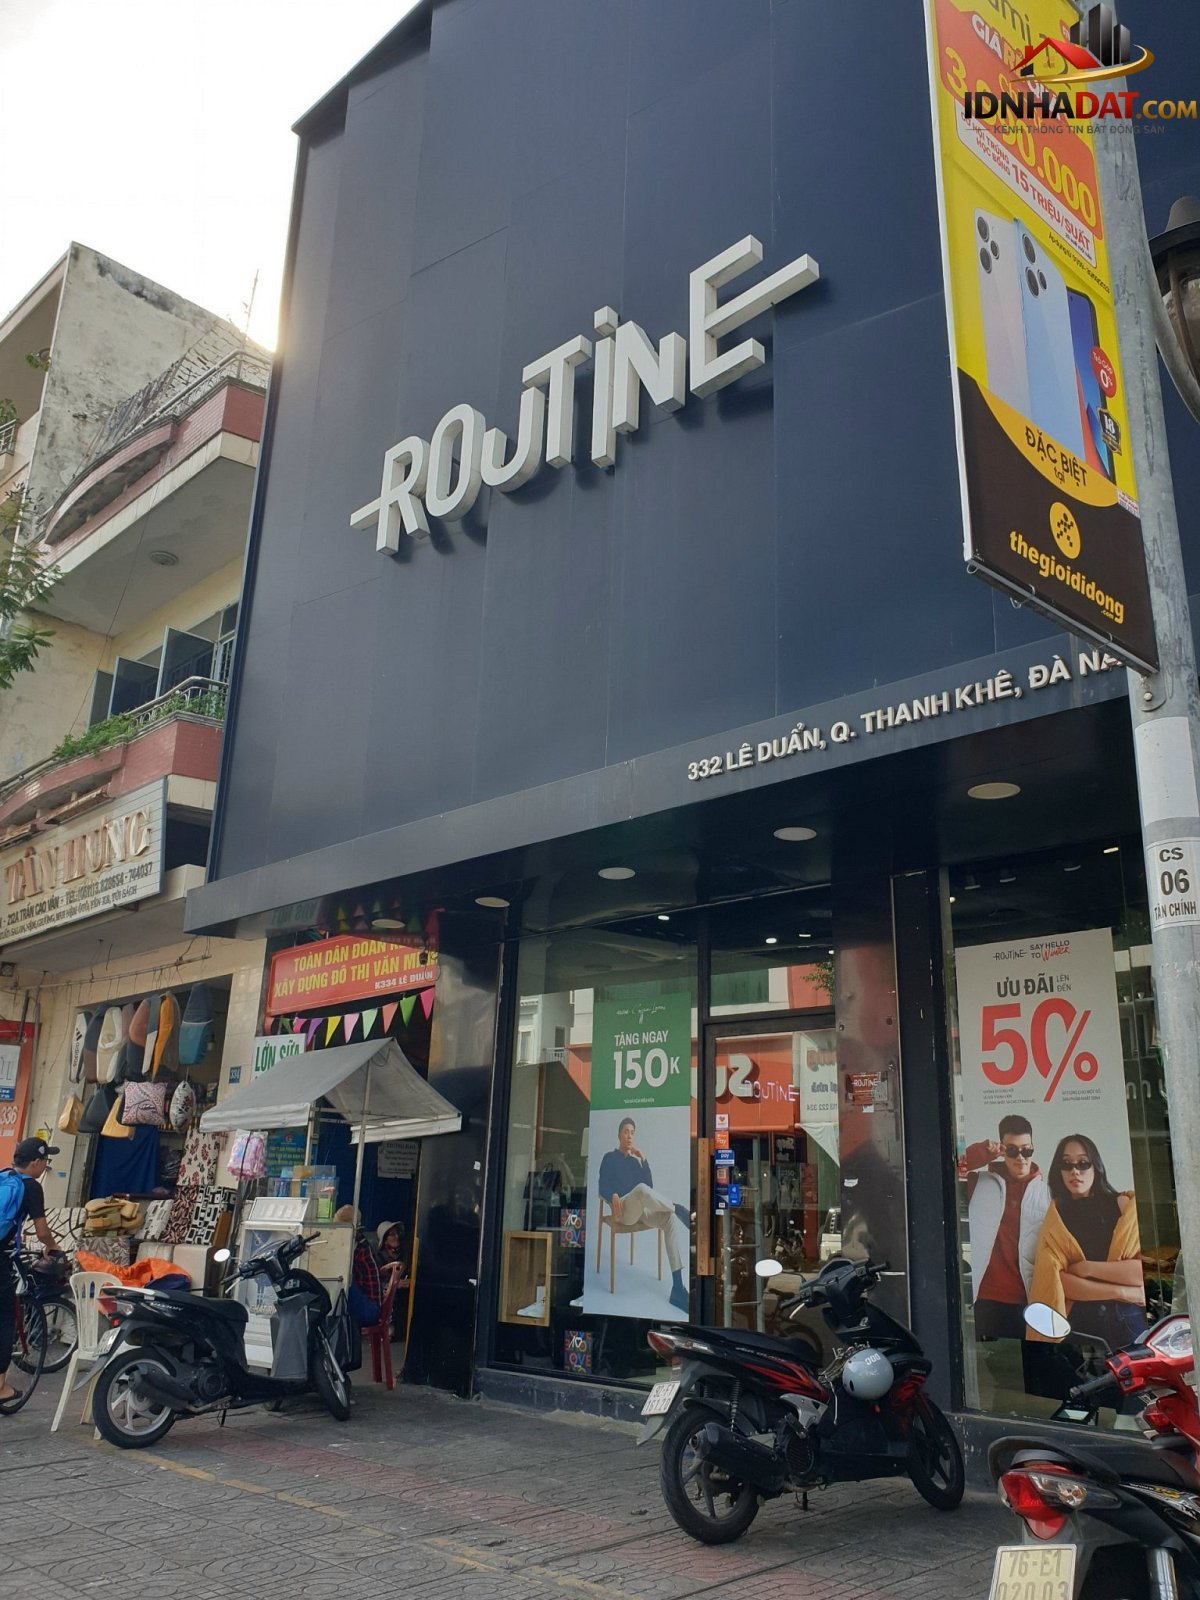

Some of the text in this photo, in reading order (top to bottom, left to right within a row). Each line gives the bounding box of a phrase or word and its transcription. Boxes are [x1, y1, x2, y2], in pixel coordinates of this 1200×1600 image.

[1012, 163, 1030, 193] 15
[1025, 425, 1088, 487] ĐẶC BIỆT
[1009, 530, 1125, 625] thegioididong
[688, 755, 723, 781] 332
[726, 743, 754, 771] LÊ
[830, 721, 858, 743] Q.
[860, 691, 950, 733] THANH
[955, 669, 1023, 710] KHÊ,
[1027, 655, 1072, 690] ĐÀ
[1159, 847, 1184, 862] CS
[1160, 868, 1190, 896] 06
[1168, 899, 1197, 917] CHÍNH
[294, 951, 322, 972] TOÀN
[325, 945, 349, 966] DÂN
[1030, 939, 1070, 951] SAY HELLO
[274, 979, 296, 998] XÂY
[299, 972, 328, 995] DỰNG
[331, 966, 347, 985] ĐÔ
[350, 962, 370, 982] THỊ
[373, 955, 400, 977] VĂN
[996, 972, 1055, 998] ƯU ĐÃI
[614, 1029, 669, 1049] TẶNG NGAY
[981, 997, 1099, 1102] 50%
[255, 1040, 277, 1072] LỚN
[1009, 1550, 1062, 1577] 76-E1
